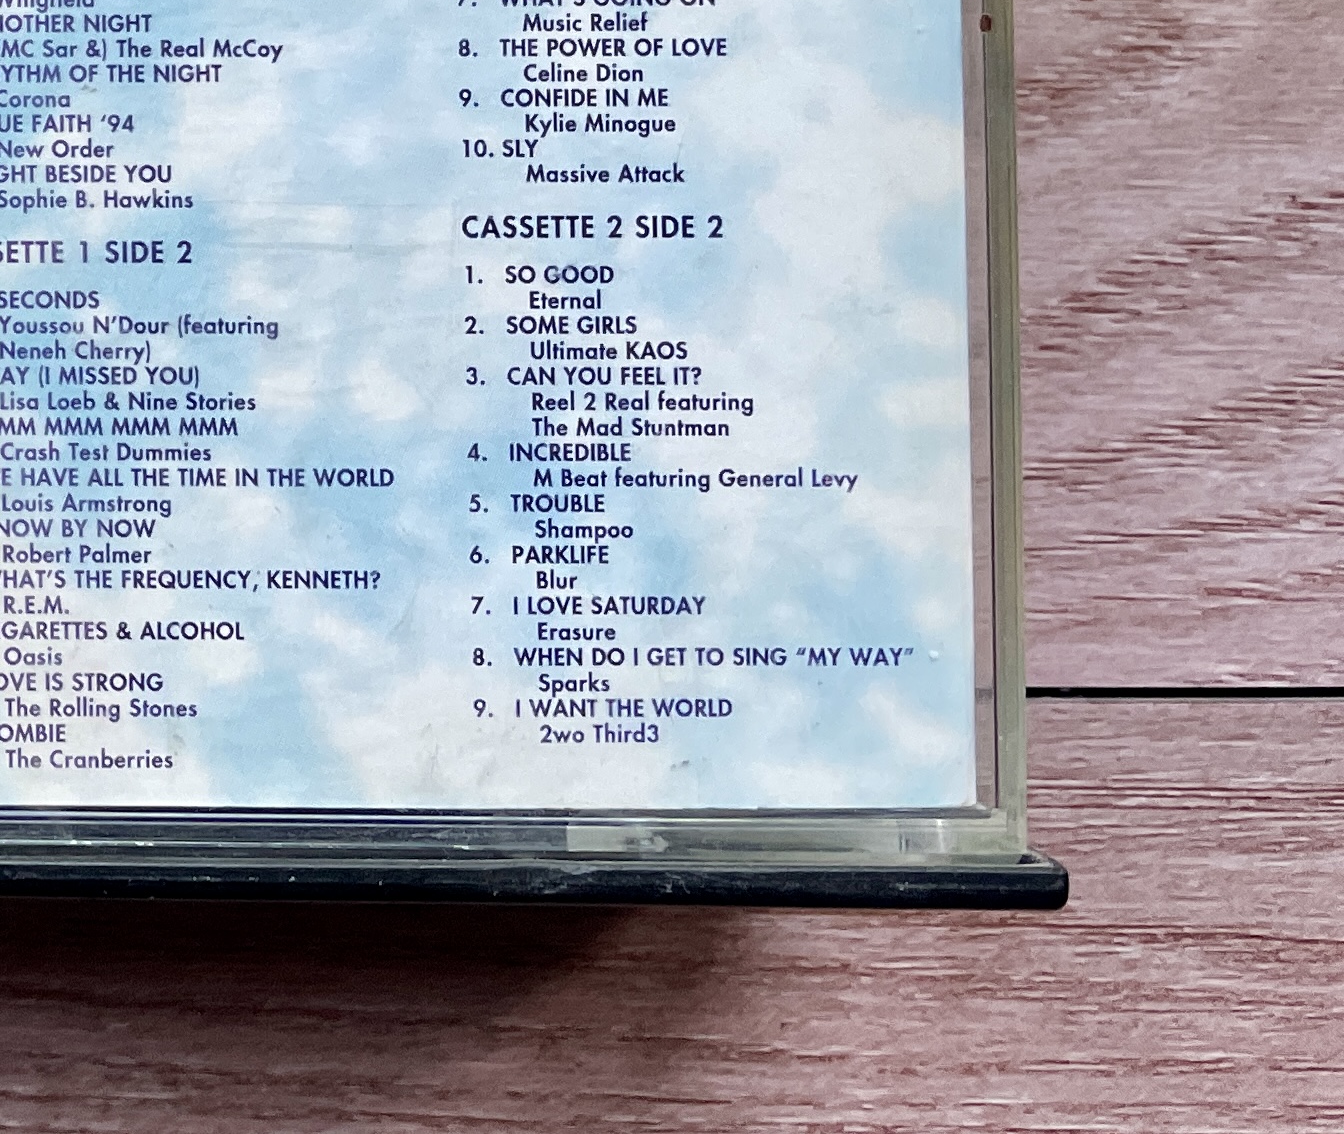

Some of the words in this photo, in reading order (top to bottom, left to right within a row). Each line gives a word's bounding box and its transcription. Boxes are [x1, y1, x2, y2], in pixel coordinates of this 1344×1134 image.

[462, 216, 593, 238] CASSETTE
[607, 215, 622, 238] 2
[636, 216, 694, 238] SIDE
[708, 215, 723, 238] 2
[79, 240, 88, 264] 1
[106, 240, 163, 263] SIDE
[177, 241, 191, 263] 2
[469, 494, 488, 513] 5.
[511, 494, 605, 512] TROUBLE
[540, 725, 584, 743] 2wo
[593, 723, 658, 743] Third3
[6, 748, 41, 768] The
[50, 748, 173, 768] Cranberries
